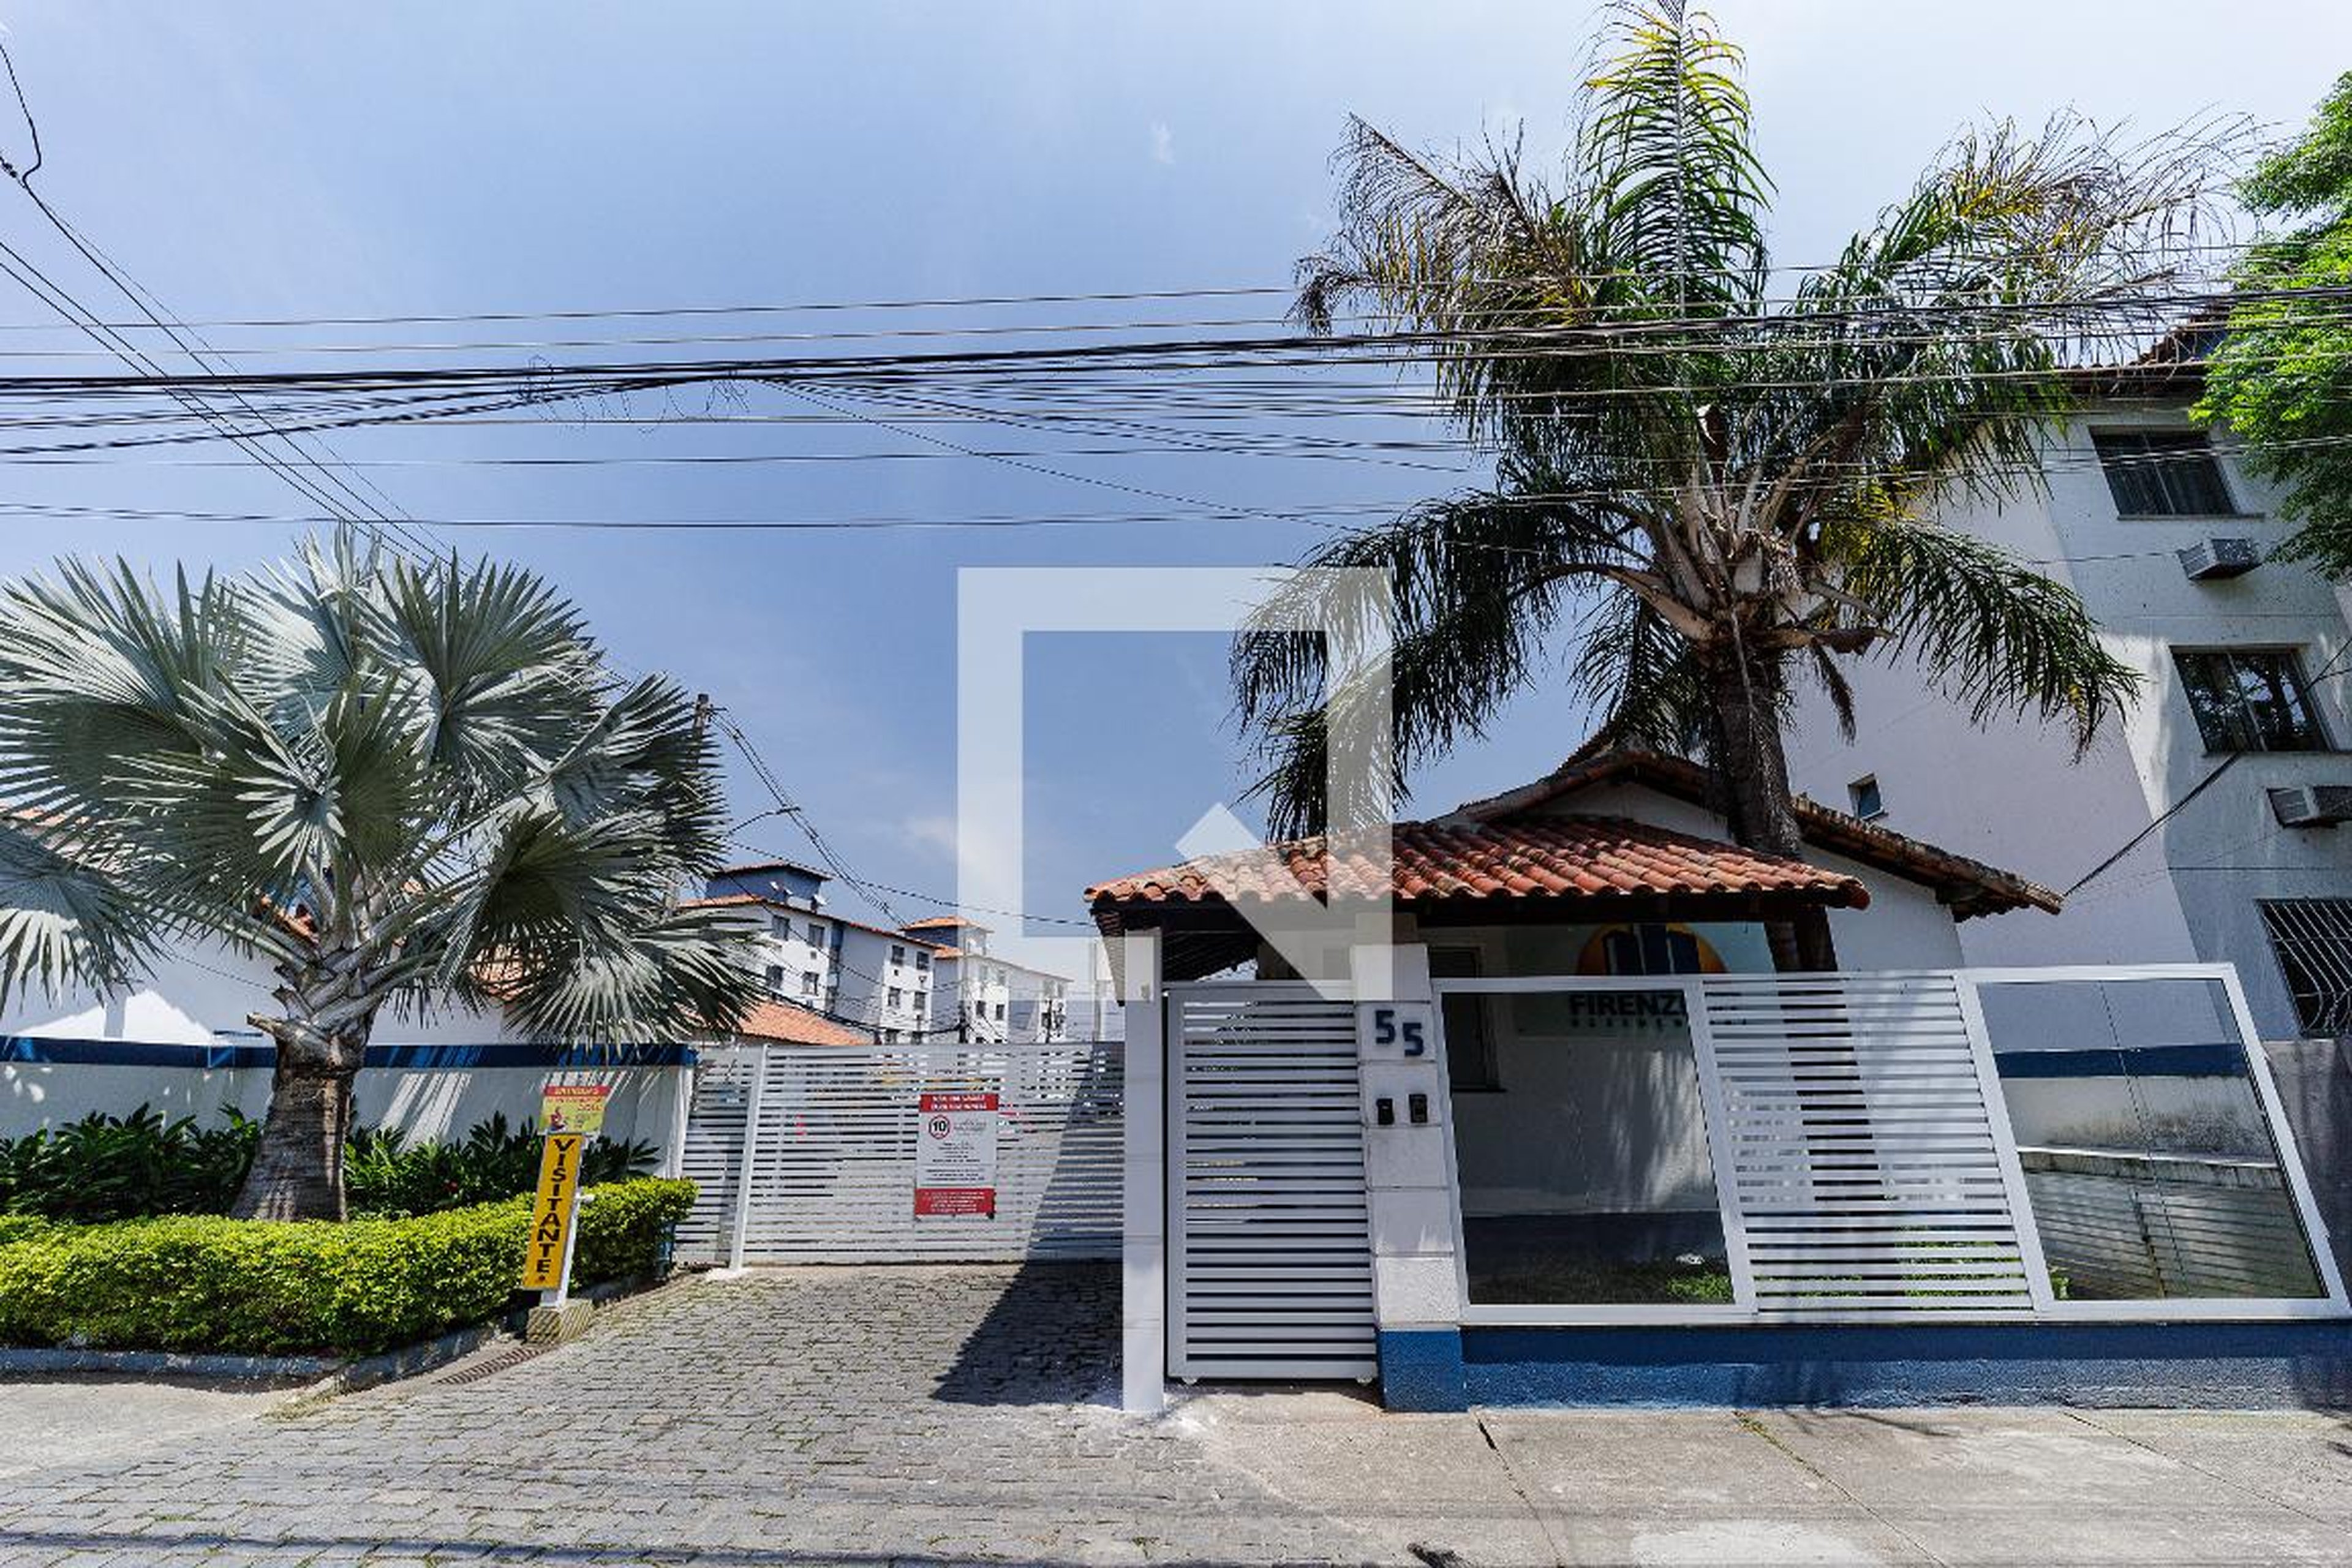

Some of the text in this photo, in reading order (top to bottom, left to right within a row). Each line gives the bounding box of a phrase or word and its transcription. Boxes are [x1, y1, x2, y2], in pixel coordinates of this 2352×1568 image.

[1569, 993, 1687, 1016] FIRENZ
[1375, 1010, 1423, 1057] 55
[933, 1120, 947, 1132] 10
[537, 1138, 576, 1273] VISITANTE
